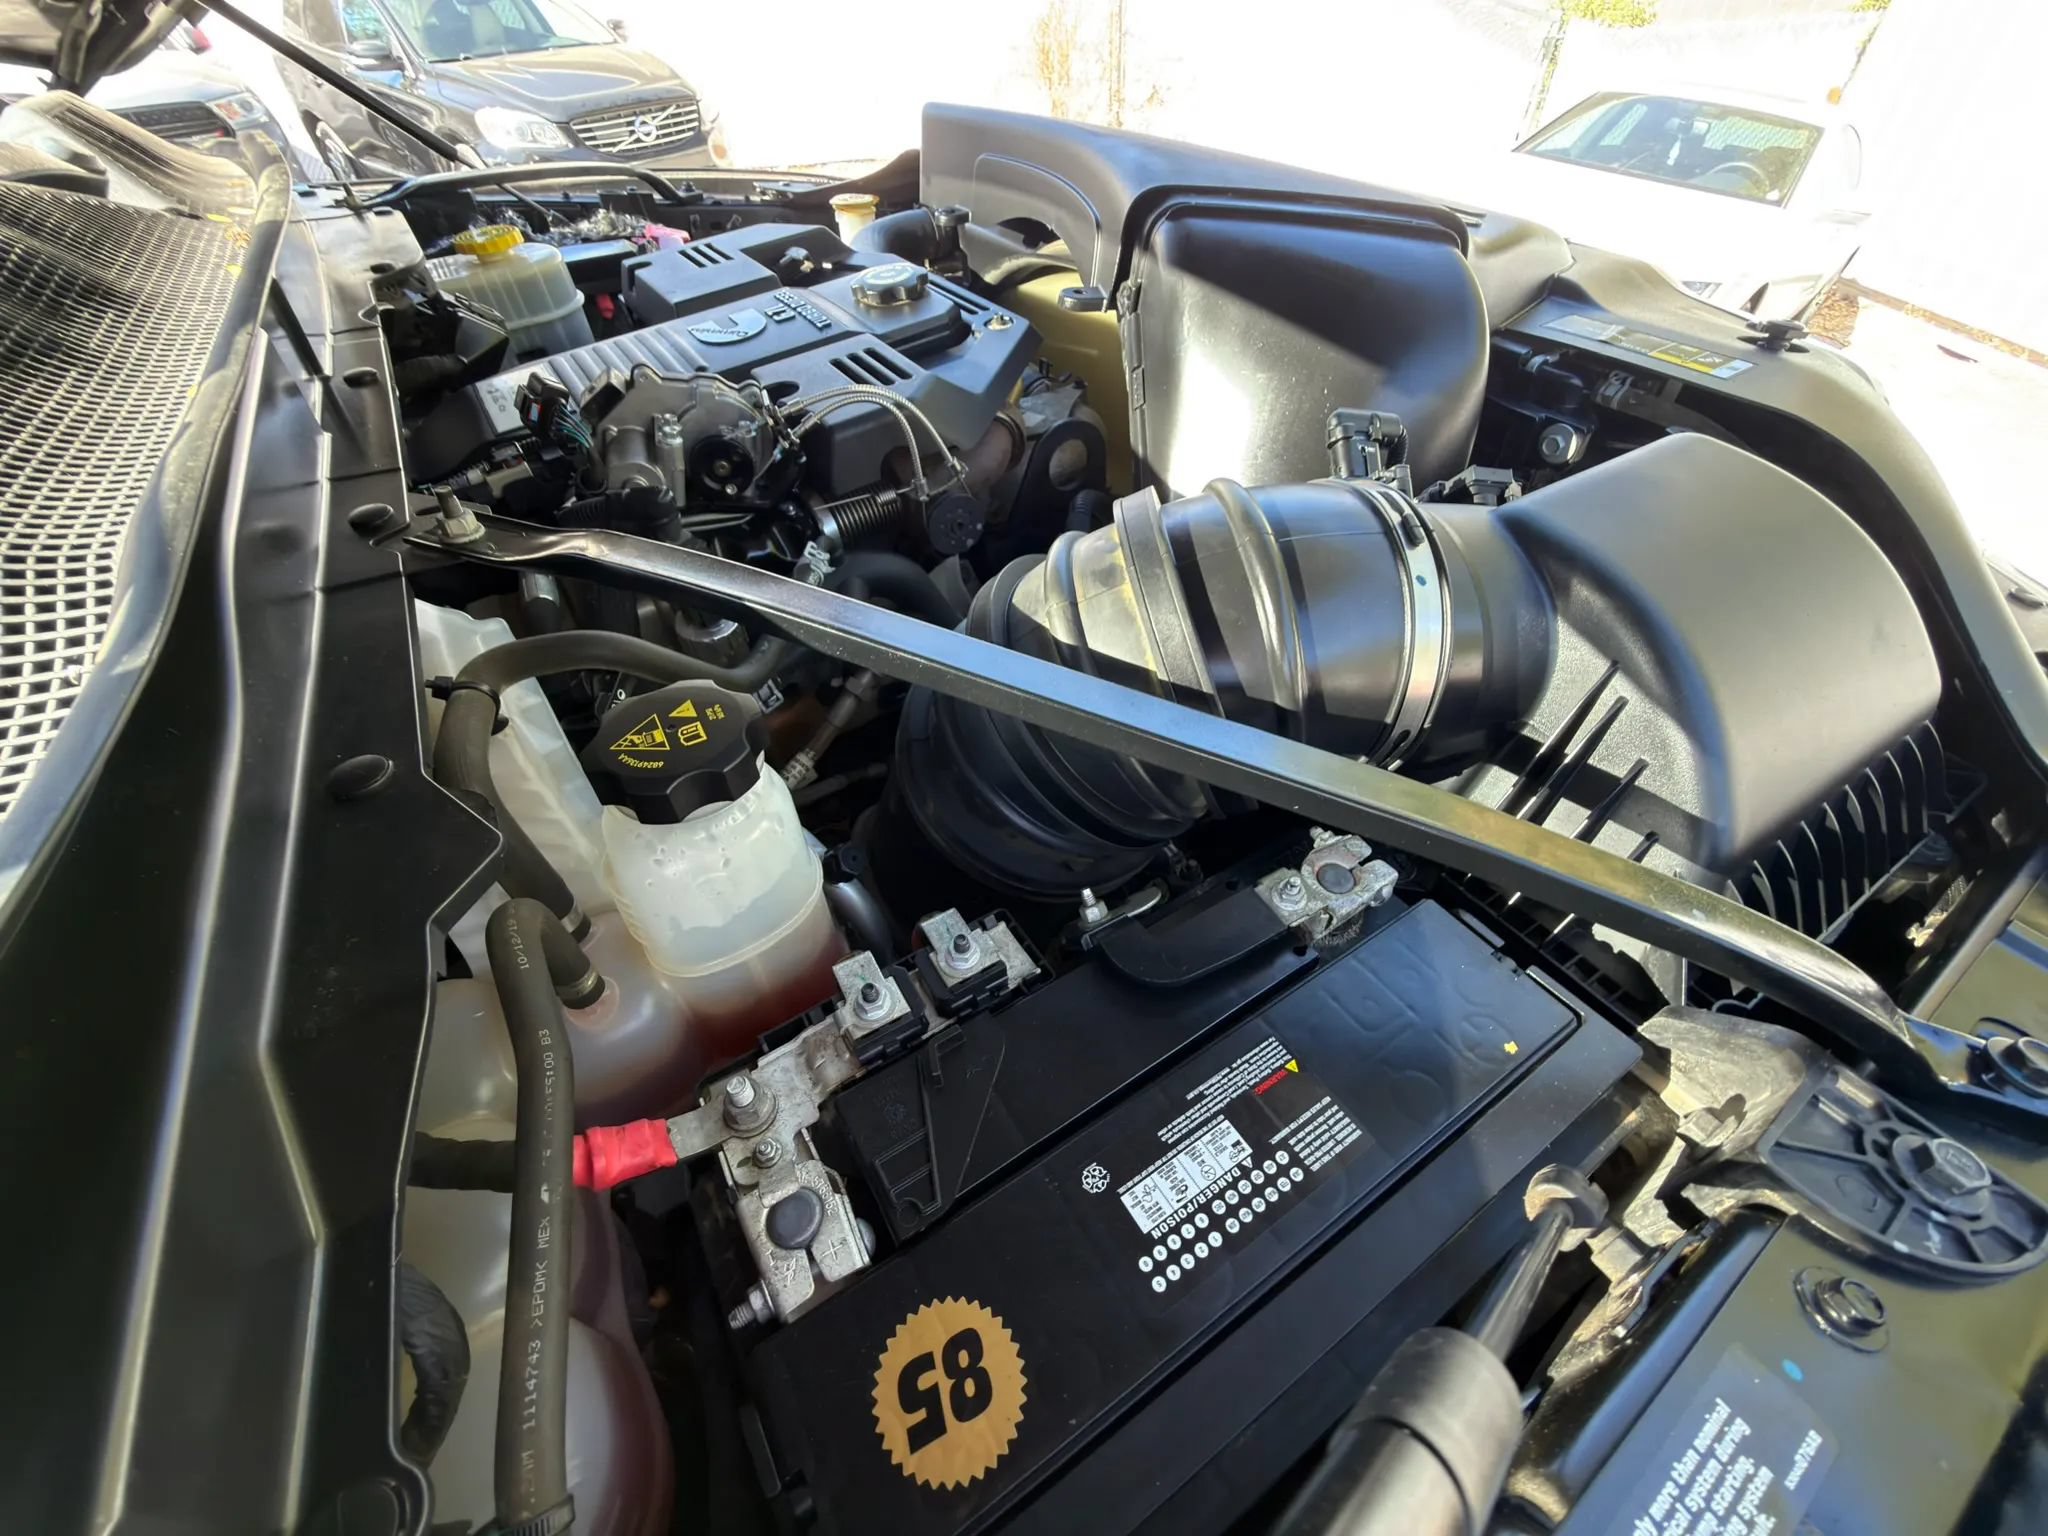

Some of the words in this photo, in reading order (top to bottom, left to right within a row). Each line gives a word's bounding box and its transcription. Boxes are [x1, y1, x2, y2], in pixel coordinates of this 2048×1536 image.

[539, 1029, 551, 1045] B3
[1151, 1167, 1241, 1239] DANGER/POISON
[523, 1340, 541, 1429] 1114743
[537, 1216, 550, 1248] MEX
[898, 1328, 992, 1454] 85
[1649, 1481, 1679, 1521] more
[1671, 1449, 1700, 1485] than
[1693, 1397, 1731, 1453] nominal
[1684, 1458, 1728, 1512] system
[1713, 1417, 1751, 1462] during
[1703, 1455, 1755, 1516] starting.
[1737, 1466, 1774, 1520] system
